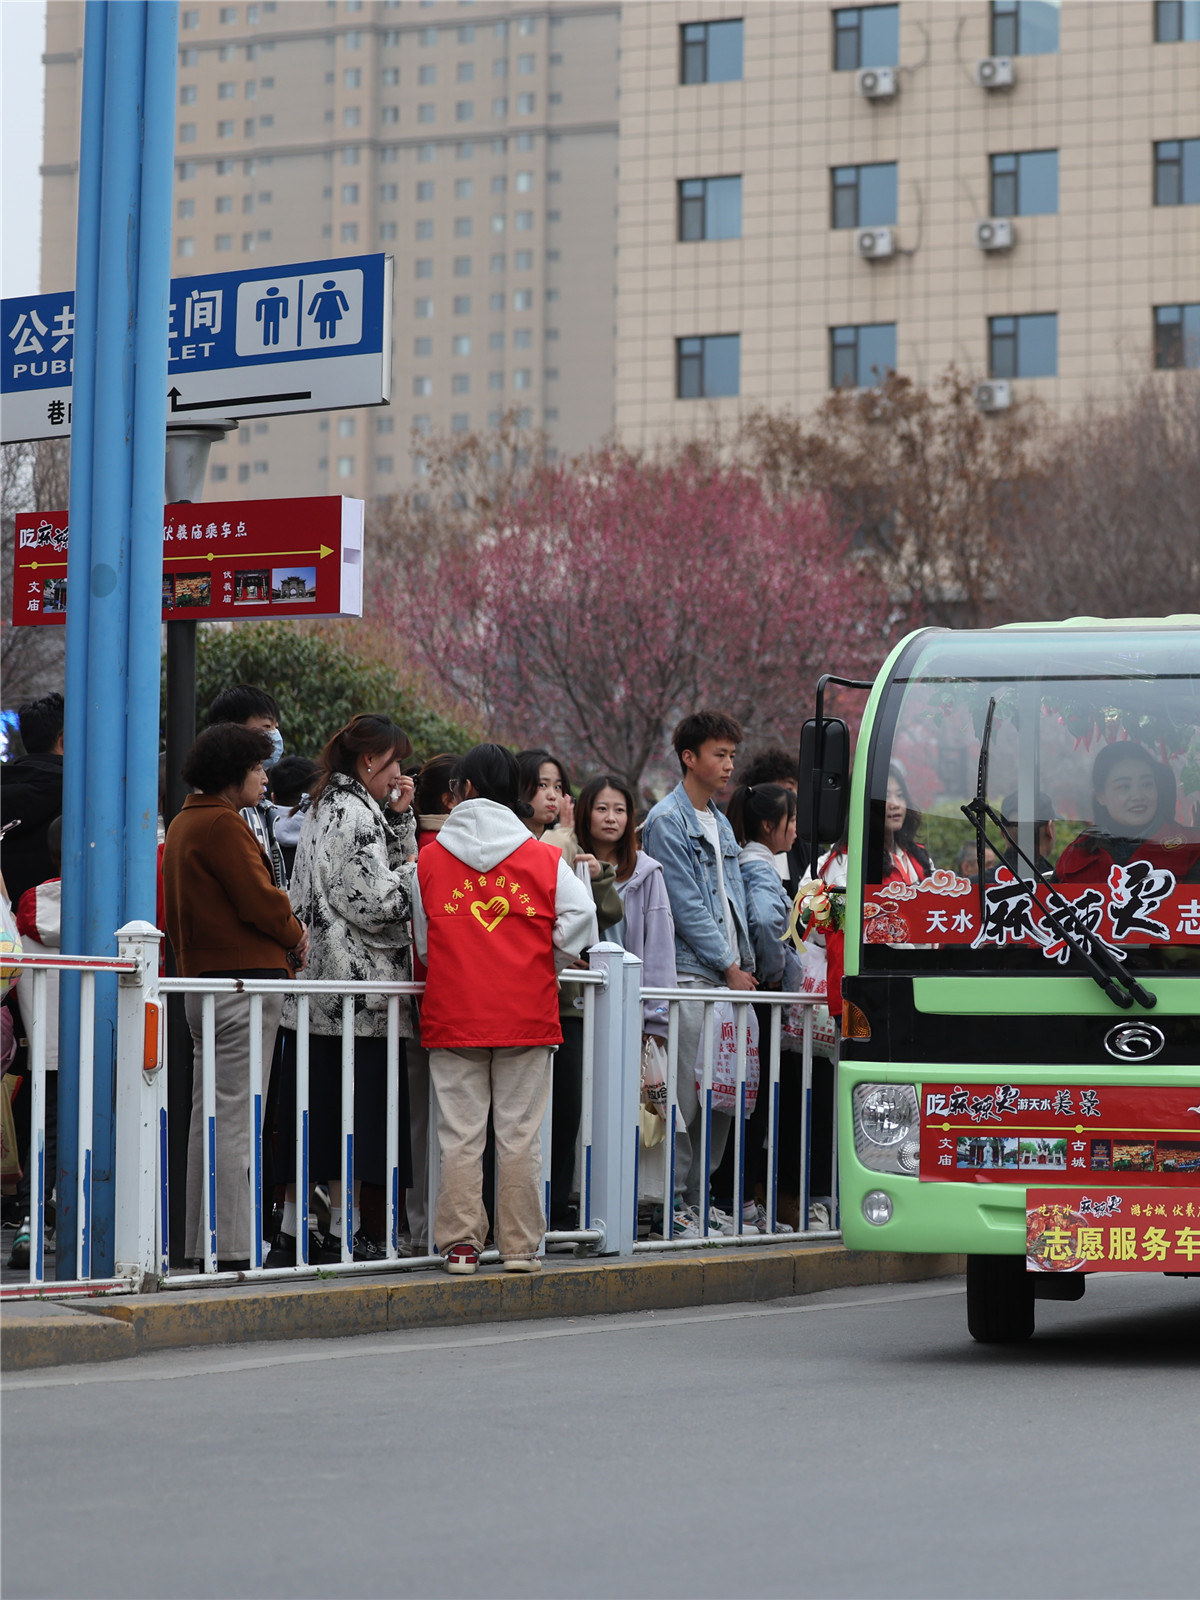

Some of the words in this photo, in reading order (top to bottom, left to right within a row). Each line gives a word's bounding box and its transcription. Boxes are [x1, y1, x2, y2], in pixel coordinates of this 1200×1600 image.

[13, 358, 74, 379] PUB
[168, 342, 215, 361] LET
[47, 400, 72, 425] 巷
[18, 519, 69, 552] 吃麻辣
[27, 581, 41, 611] 文庙
[938, 1137, 953, 1166] 文庙
[1070, 1140, 1087, 1169] 古城
[1130, 1203, 1167, 1218] 游古城
